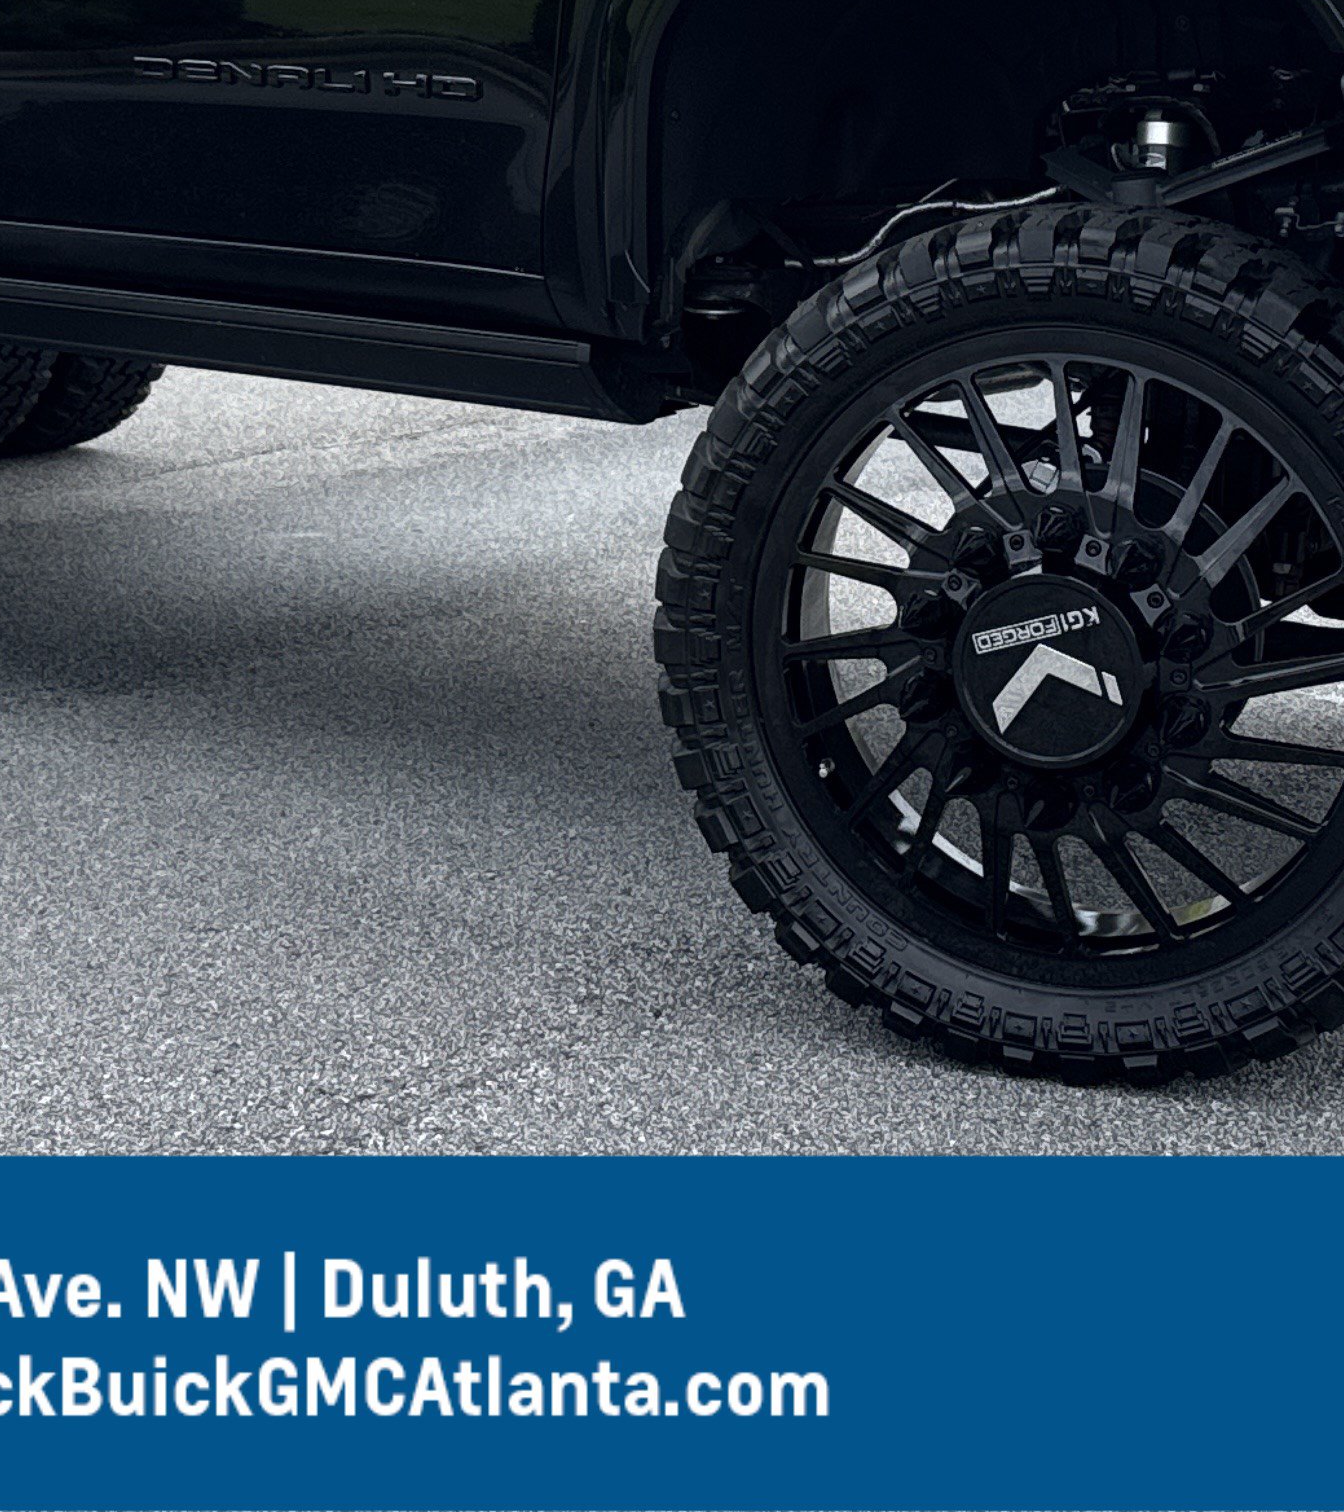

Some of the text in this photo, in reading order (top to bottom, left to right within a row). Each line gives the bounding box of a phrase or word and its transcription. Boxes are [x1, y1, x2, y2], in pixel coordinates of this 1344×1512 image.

[132, 56, 485, 103] DENALI HD
[976, 617, 1058, 650] FORGED
